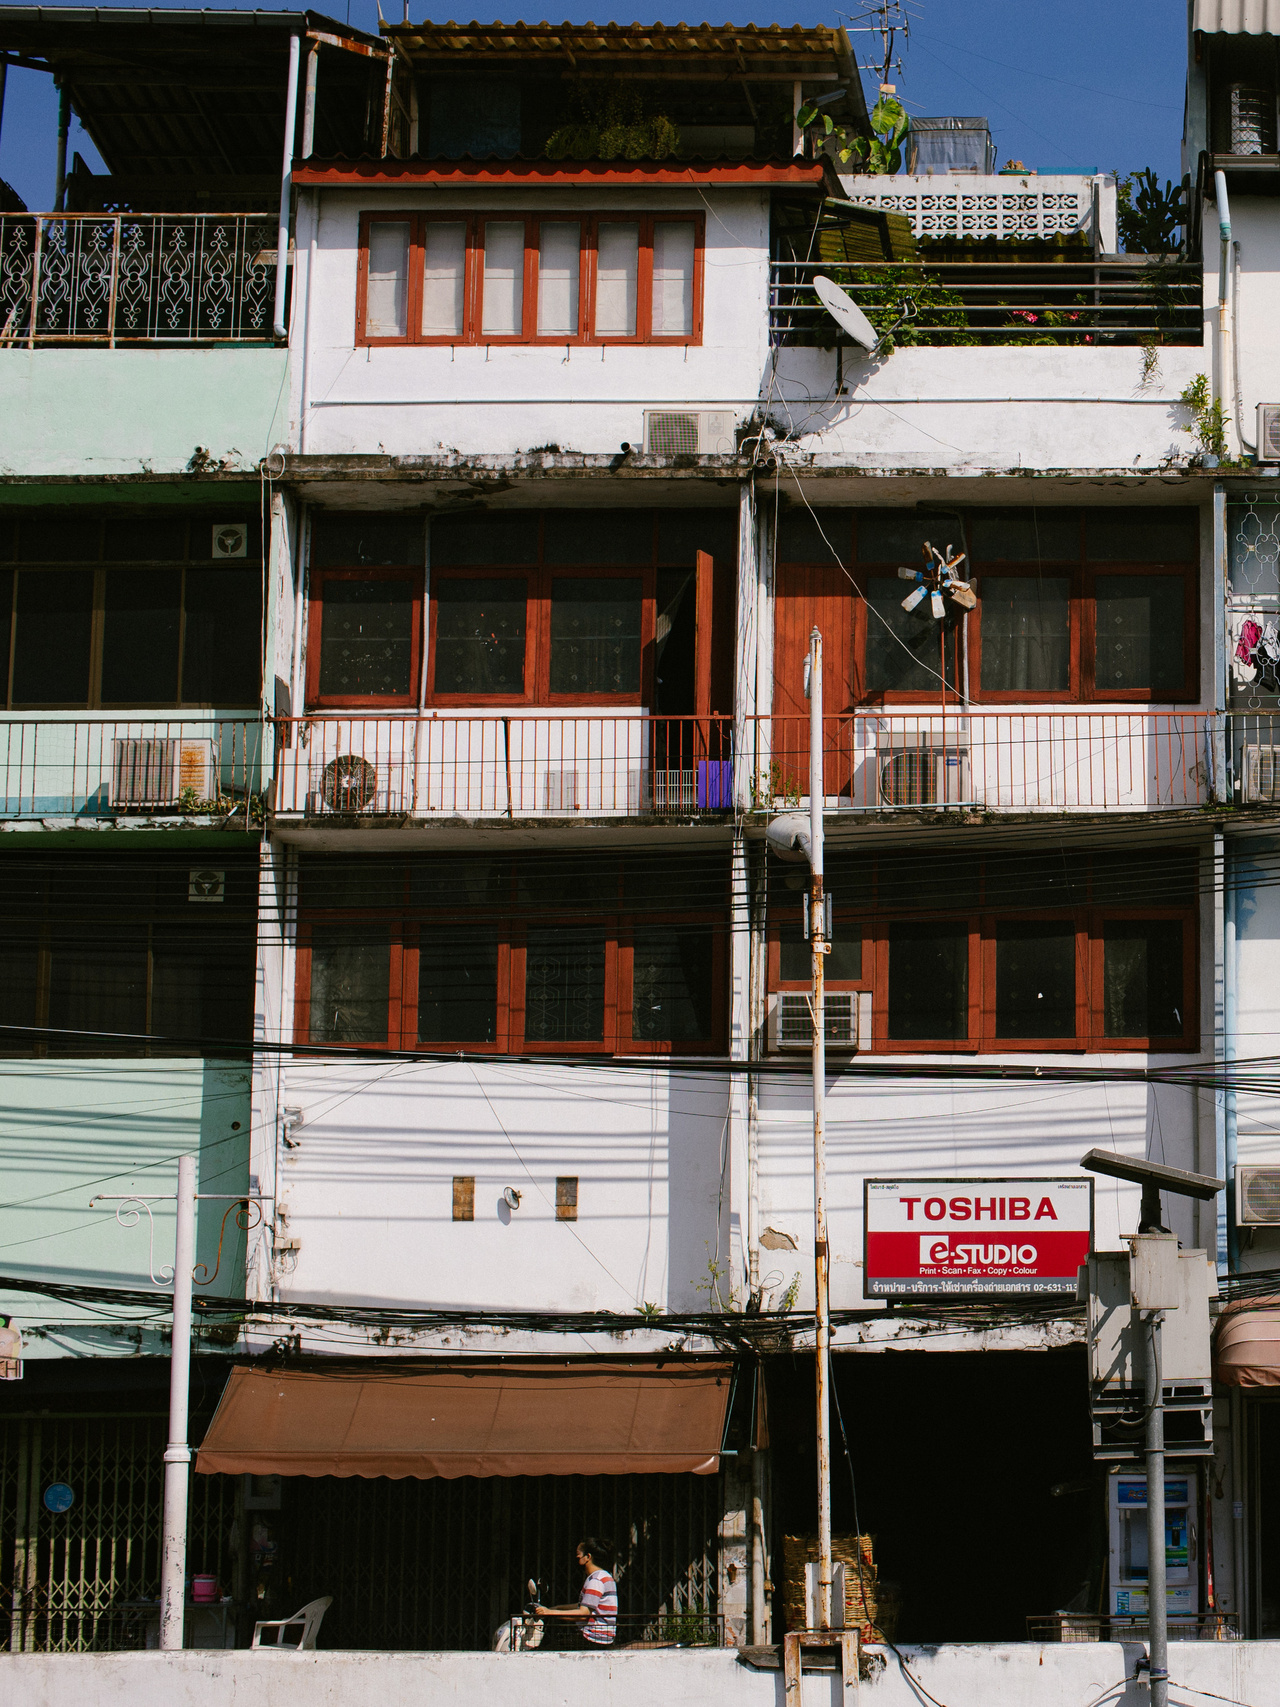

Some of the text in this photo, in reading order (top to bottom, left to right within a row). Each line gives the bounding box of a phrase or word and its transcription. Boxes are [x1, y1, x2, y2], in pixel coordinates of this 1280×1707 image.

[900, 1197, 1058, 1221] TOSHIBA
[919, 1267, 1038, 1277] Print Scan Fax Copy Colour
